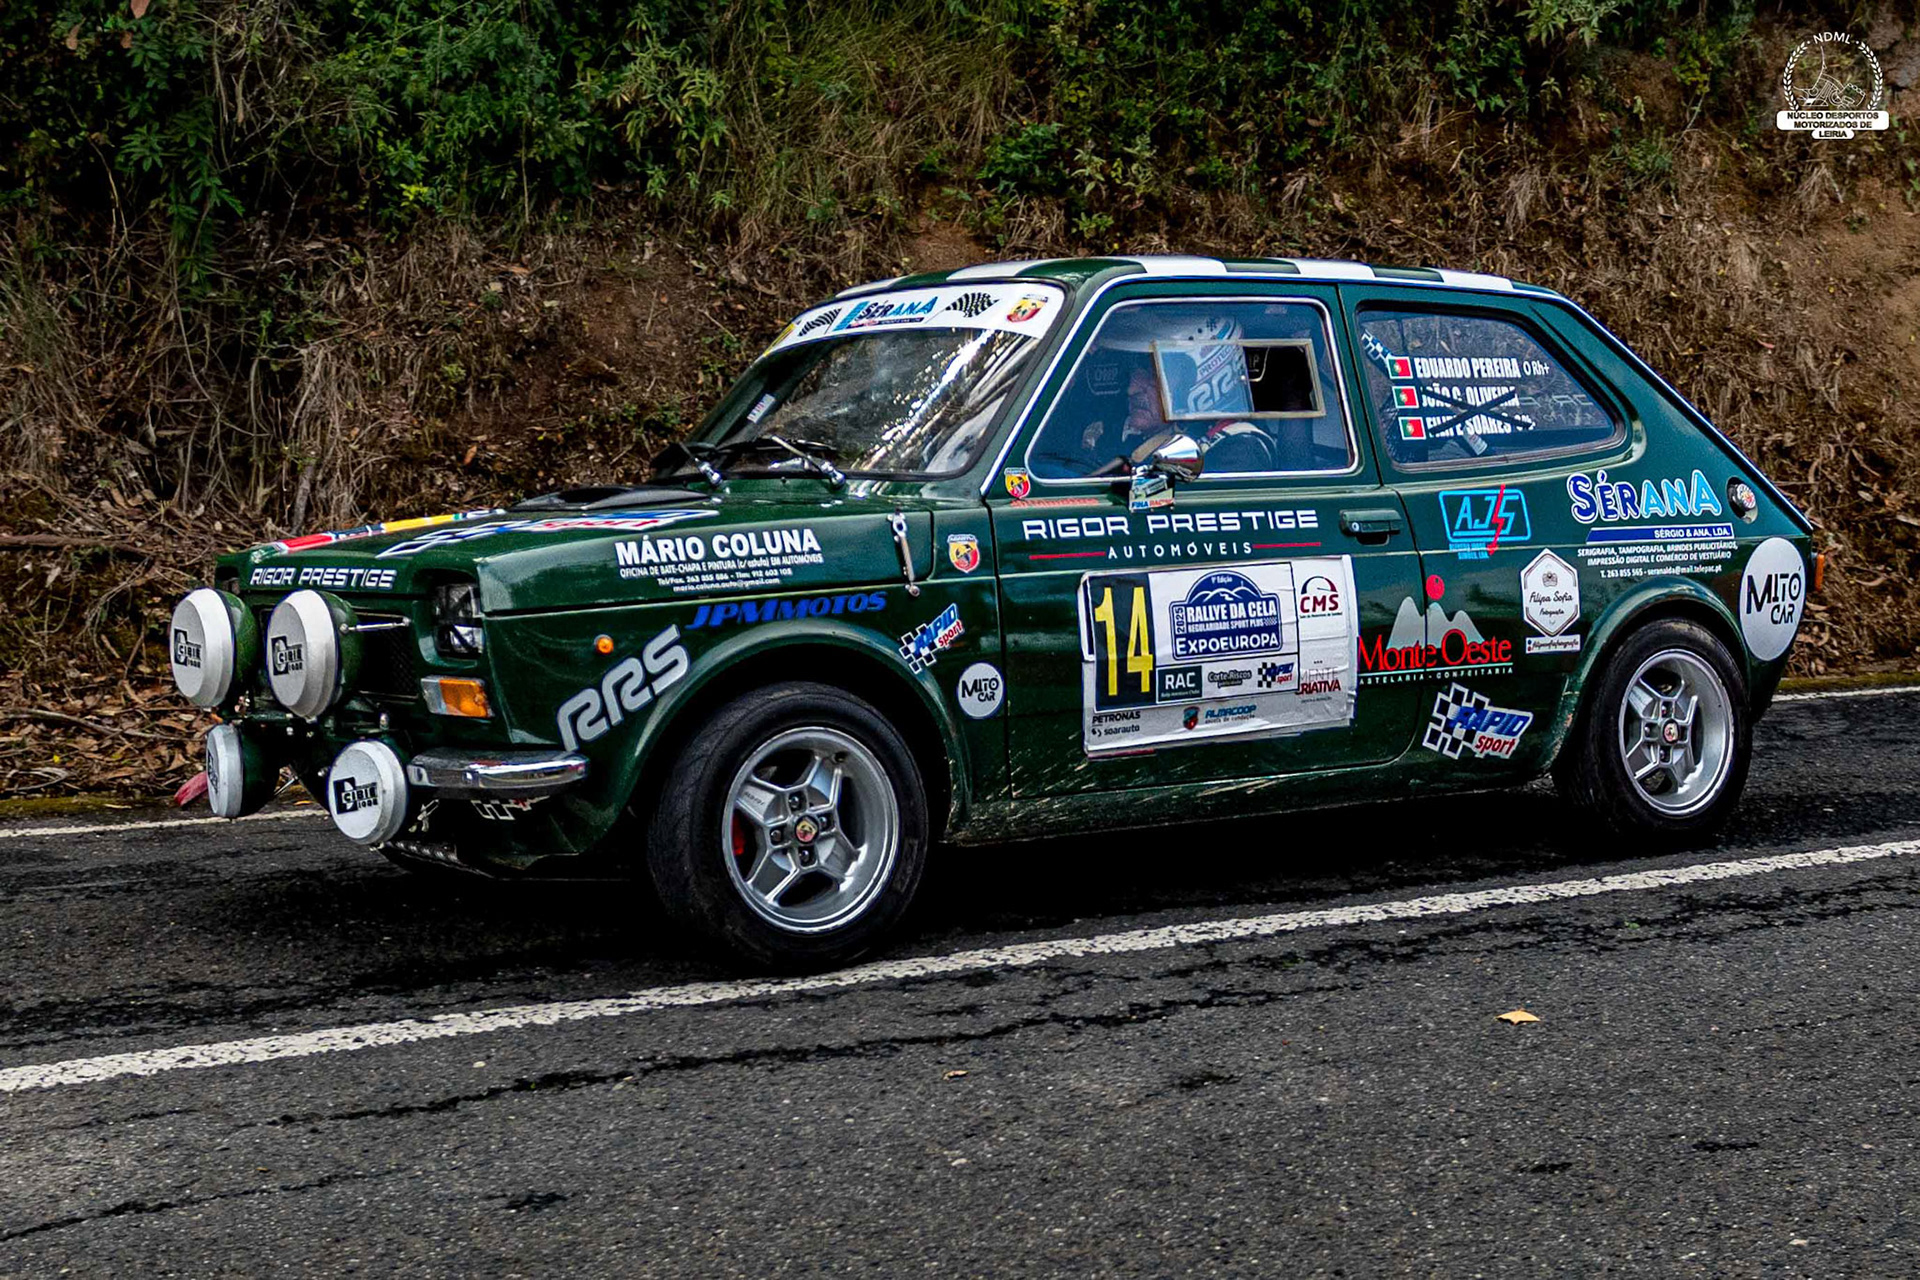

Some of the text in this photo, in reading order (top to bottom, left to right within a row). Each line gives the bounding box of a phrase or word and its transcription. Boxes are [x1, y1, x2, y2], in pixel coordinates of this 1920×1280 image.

[1413, 357, 1472, 379] EDUARDO
[1471, 357, 1522, 379] PEREIRA
[1465, 412, 1512, 435] SOARES
[1567, 469, 1722, 524] SÉRANA
[1022, 509, 1319, 540] RIGOR PRESTIGE
[1454, 495, 1520, 535] AJS
[1654, 529, 1685, 539] SÉRGIO
[1686, 528, 1692, 537] &
[615, 528, 821, 565] MÁRIO COLUNA
[1108, 541, 1253, 560] AUTOMÓVEIS
[1577, 547, 1617, 557] SERIGRAFIA,
[1618, 544, 1665, 555] TAMPOGRAFIA,
[1666, 542, 1693, 552] BRINDES
[620, 566, 649, 578] OFICINA
[649, 566, 660, 576] DE
[660, 562, 701, 575] BATE-CHAPA
[701, 562, 707, 571] E
[707, 560, 736, 571] PINTURA
[770, 556, 781, 566] EM
[782, 552, 824, 565] AUTOMÓVEIS
[1587, 555, 1625, 566] IMPRESSÃO
[1626, 555, 1649, 564] DIGITAL
[1656, 551, 1689, 562] COMÉRCIO
[1689, 552, 1698, 560] DE
[1698, 550, 1732, 560] VESTUÁRIO
[250, 567, 398, 590] RIGOR PRESTIGE
[1607, 569, 1619, 578] 263
[1300, 593, 1339, 614] CMS
[1552, 591, 1574, 604] Sofia
[685, 591, 889, 630] JPMMOTOS
[1174, 607, 1184, 633] 2025
[1186, 600, 1277, 623] RALLYE DA CELA
[1770, 603, 1795, 625] CAR
[938, 619, 964, 648] sport
[1230, 619, 1249, 629] SPORT
[1250, 618, 1264, 627] PLUS
[1094, 586, 1154, 696] 14
[1358, 628, 1513, 671] Monte Oeste
[1165, 672, 1196, 690] RAC
[1277, 674, 1293, 685] sport
[1359, 673, 1425, 685] ASTELARIA
[1436, 667, 1513, 680] CONFEITARIA
[977, 691, 996, 702] CAR
[1092, 711, 1141, 724] PETRONAS
[1205, 705, 1257, 718] ALMACOOP
[1450, 705, 1531, 737] RAPID
[1104, 724, 1140, 736] soarauto
[1475, 734, 1517, 756] sport
